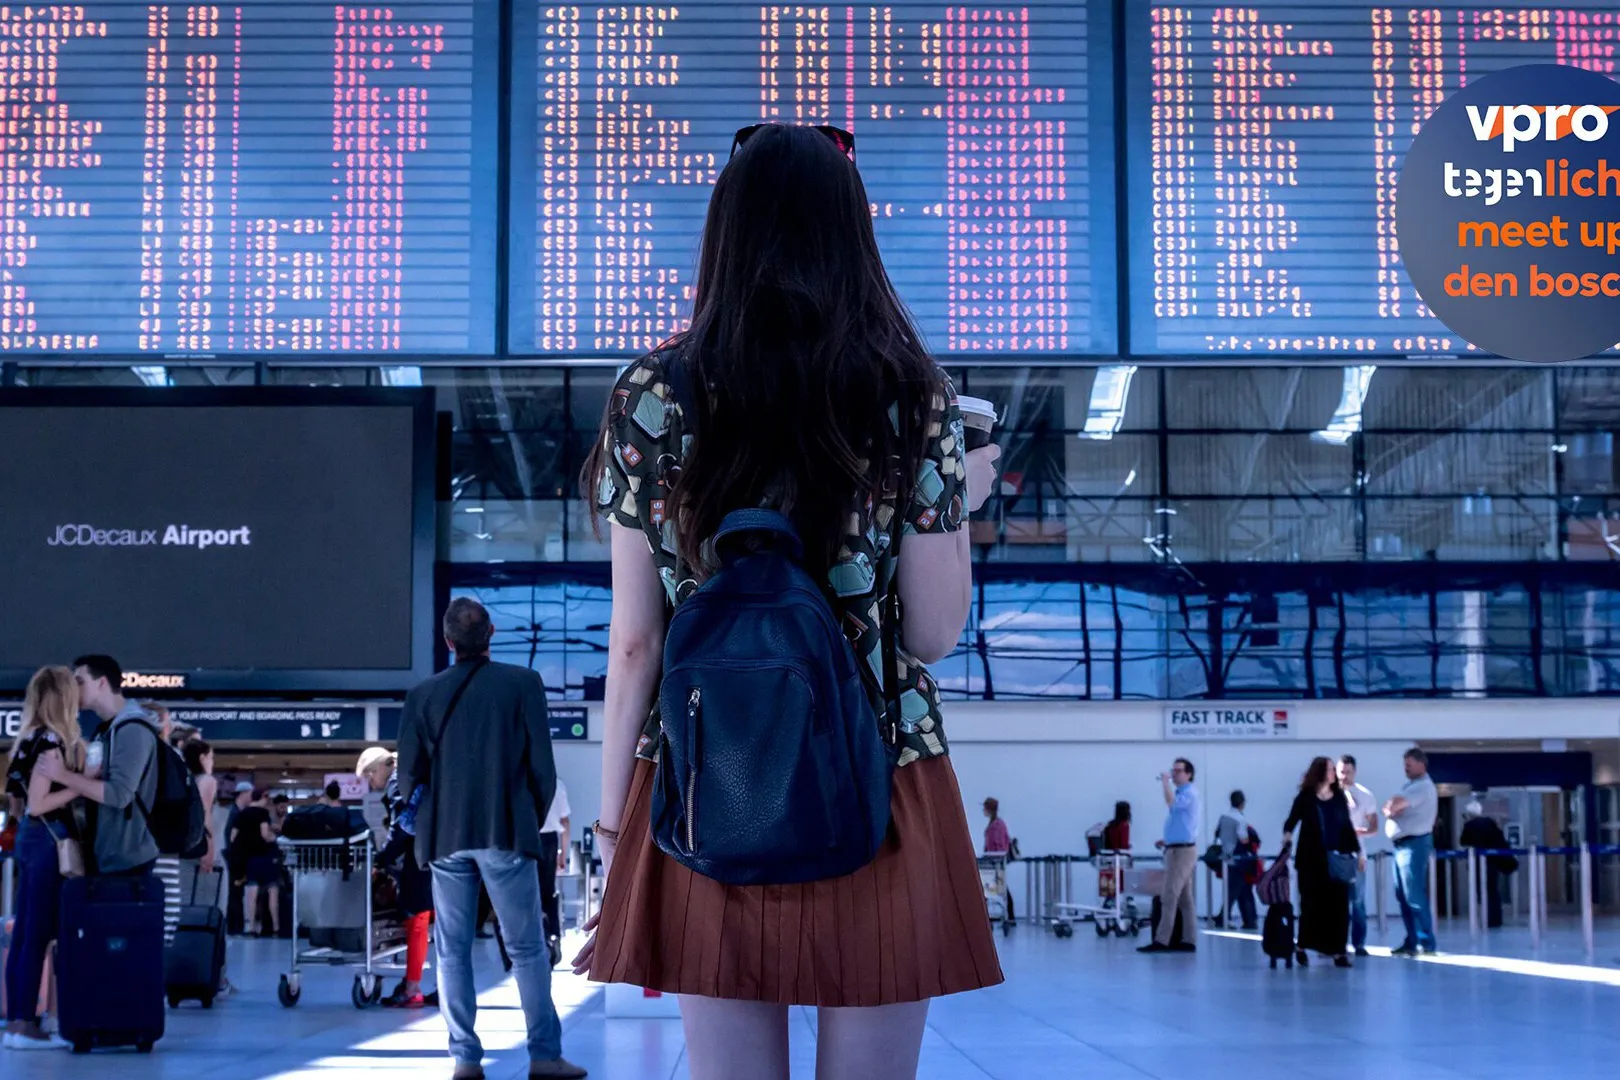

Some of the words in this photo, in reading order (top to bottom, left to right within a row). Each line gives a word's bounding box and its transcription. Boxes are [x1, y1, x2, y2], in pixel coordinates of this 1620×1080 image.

[47, 524, 157, 546] JCDecaux
[162, 525, 251, 549] Airport
[120, 672, 185, 688] Decaux
[178, 711, 199, 721] YOUR
[199, 711, 238, 721] PASSPORT
[239, 711, 255, 721] AND
[256, 711, 294, 721] BOARDING
[295, 711, 314, 721] PASS
[314, 711, 341, 721] READY
[1172, 710, 1209, 724] FAST
[1214, 710, 1265, 724] TRACK
